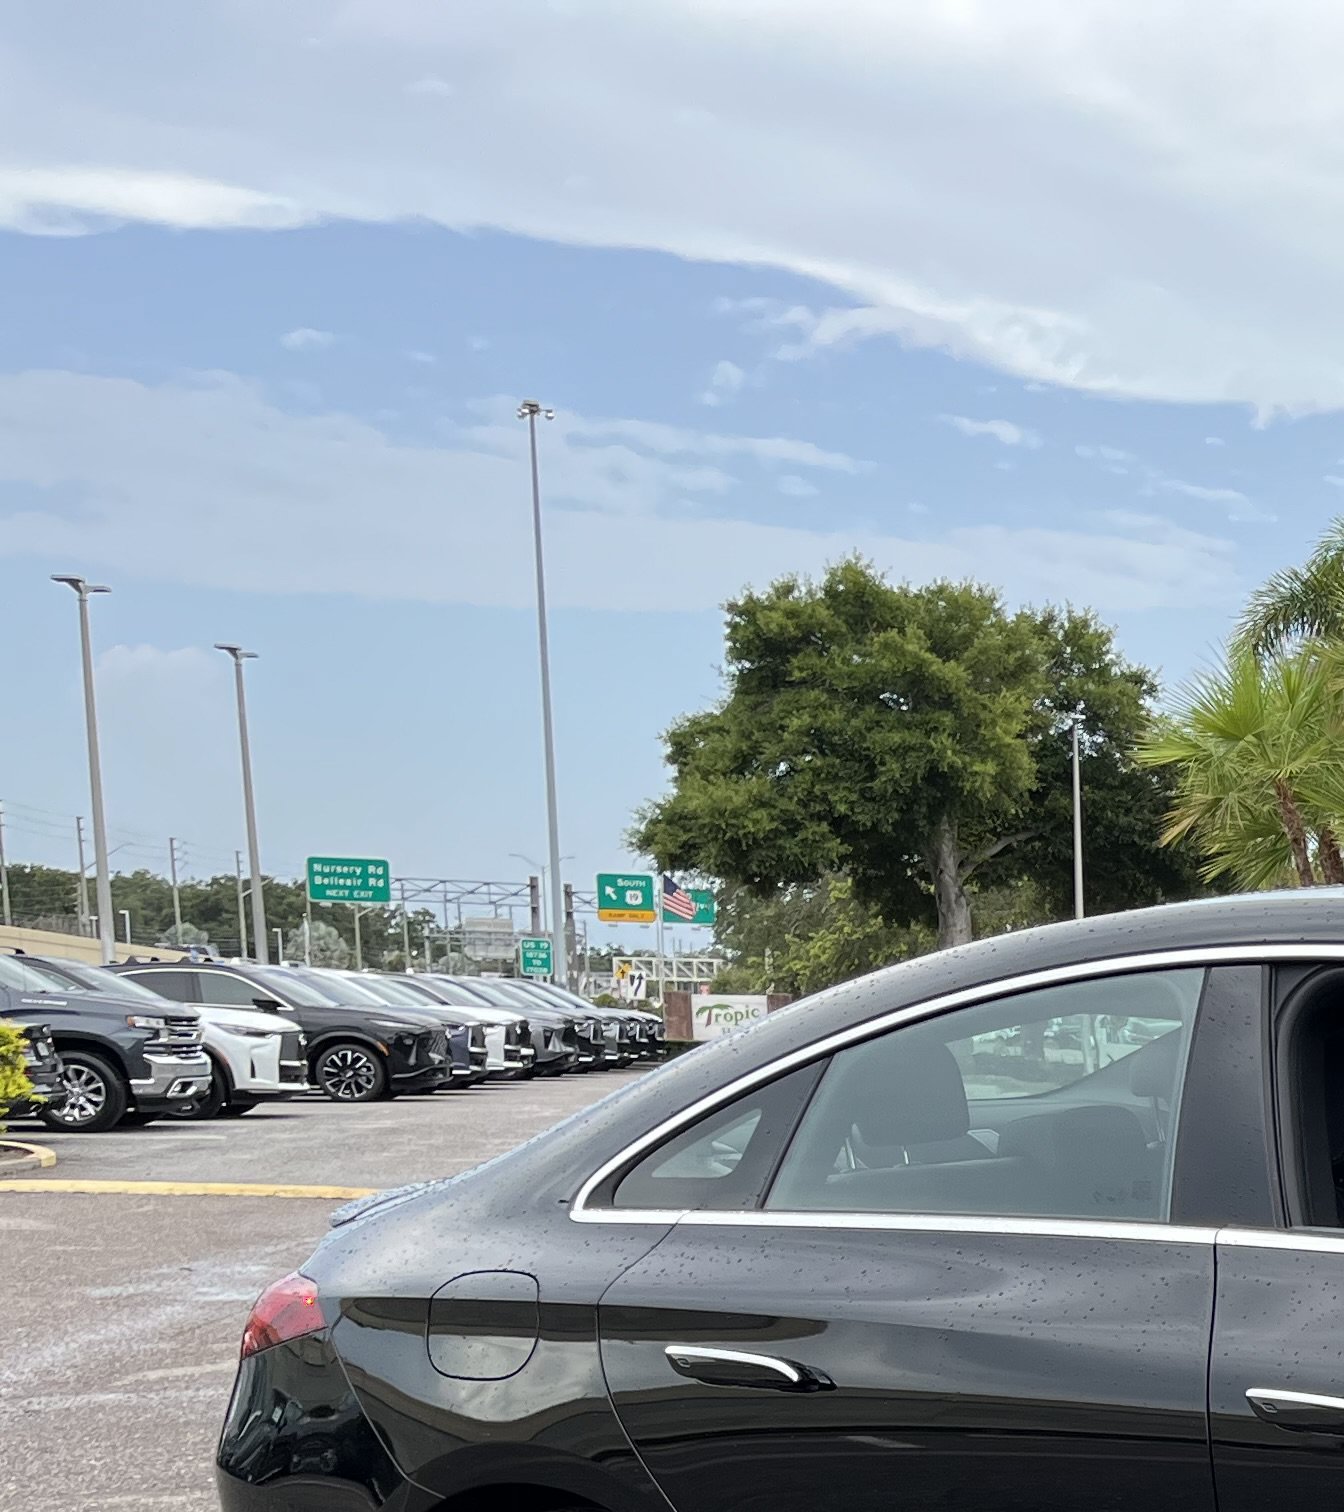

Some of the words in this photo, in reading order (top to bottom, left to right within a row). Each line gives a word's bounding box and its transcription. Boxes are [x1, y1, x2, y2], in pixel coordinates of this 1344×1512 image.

[313, 863, 362, 876] Nursery
[367, 865, 384, 875] Rd
[314, 875, 363, 887] Belleair
[368, 878, 385, 887] Rd
[523, 941, 536, 949] US
[696, 1003, 760, 1029] Tropic
